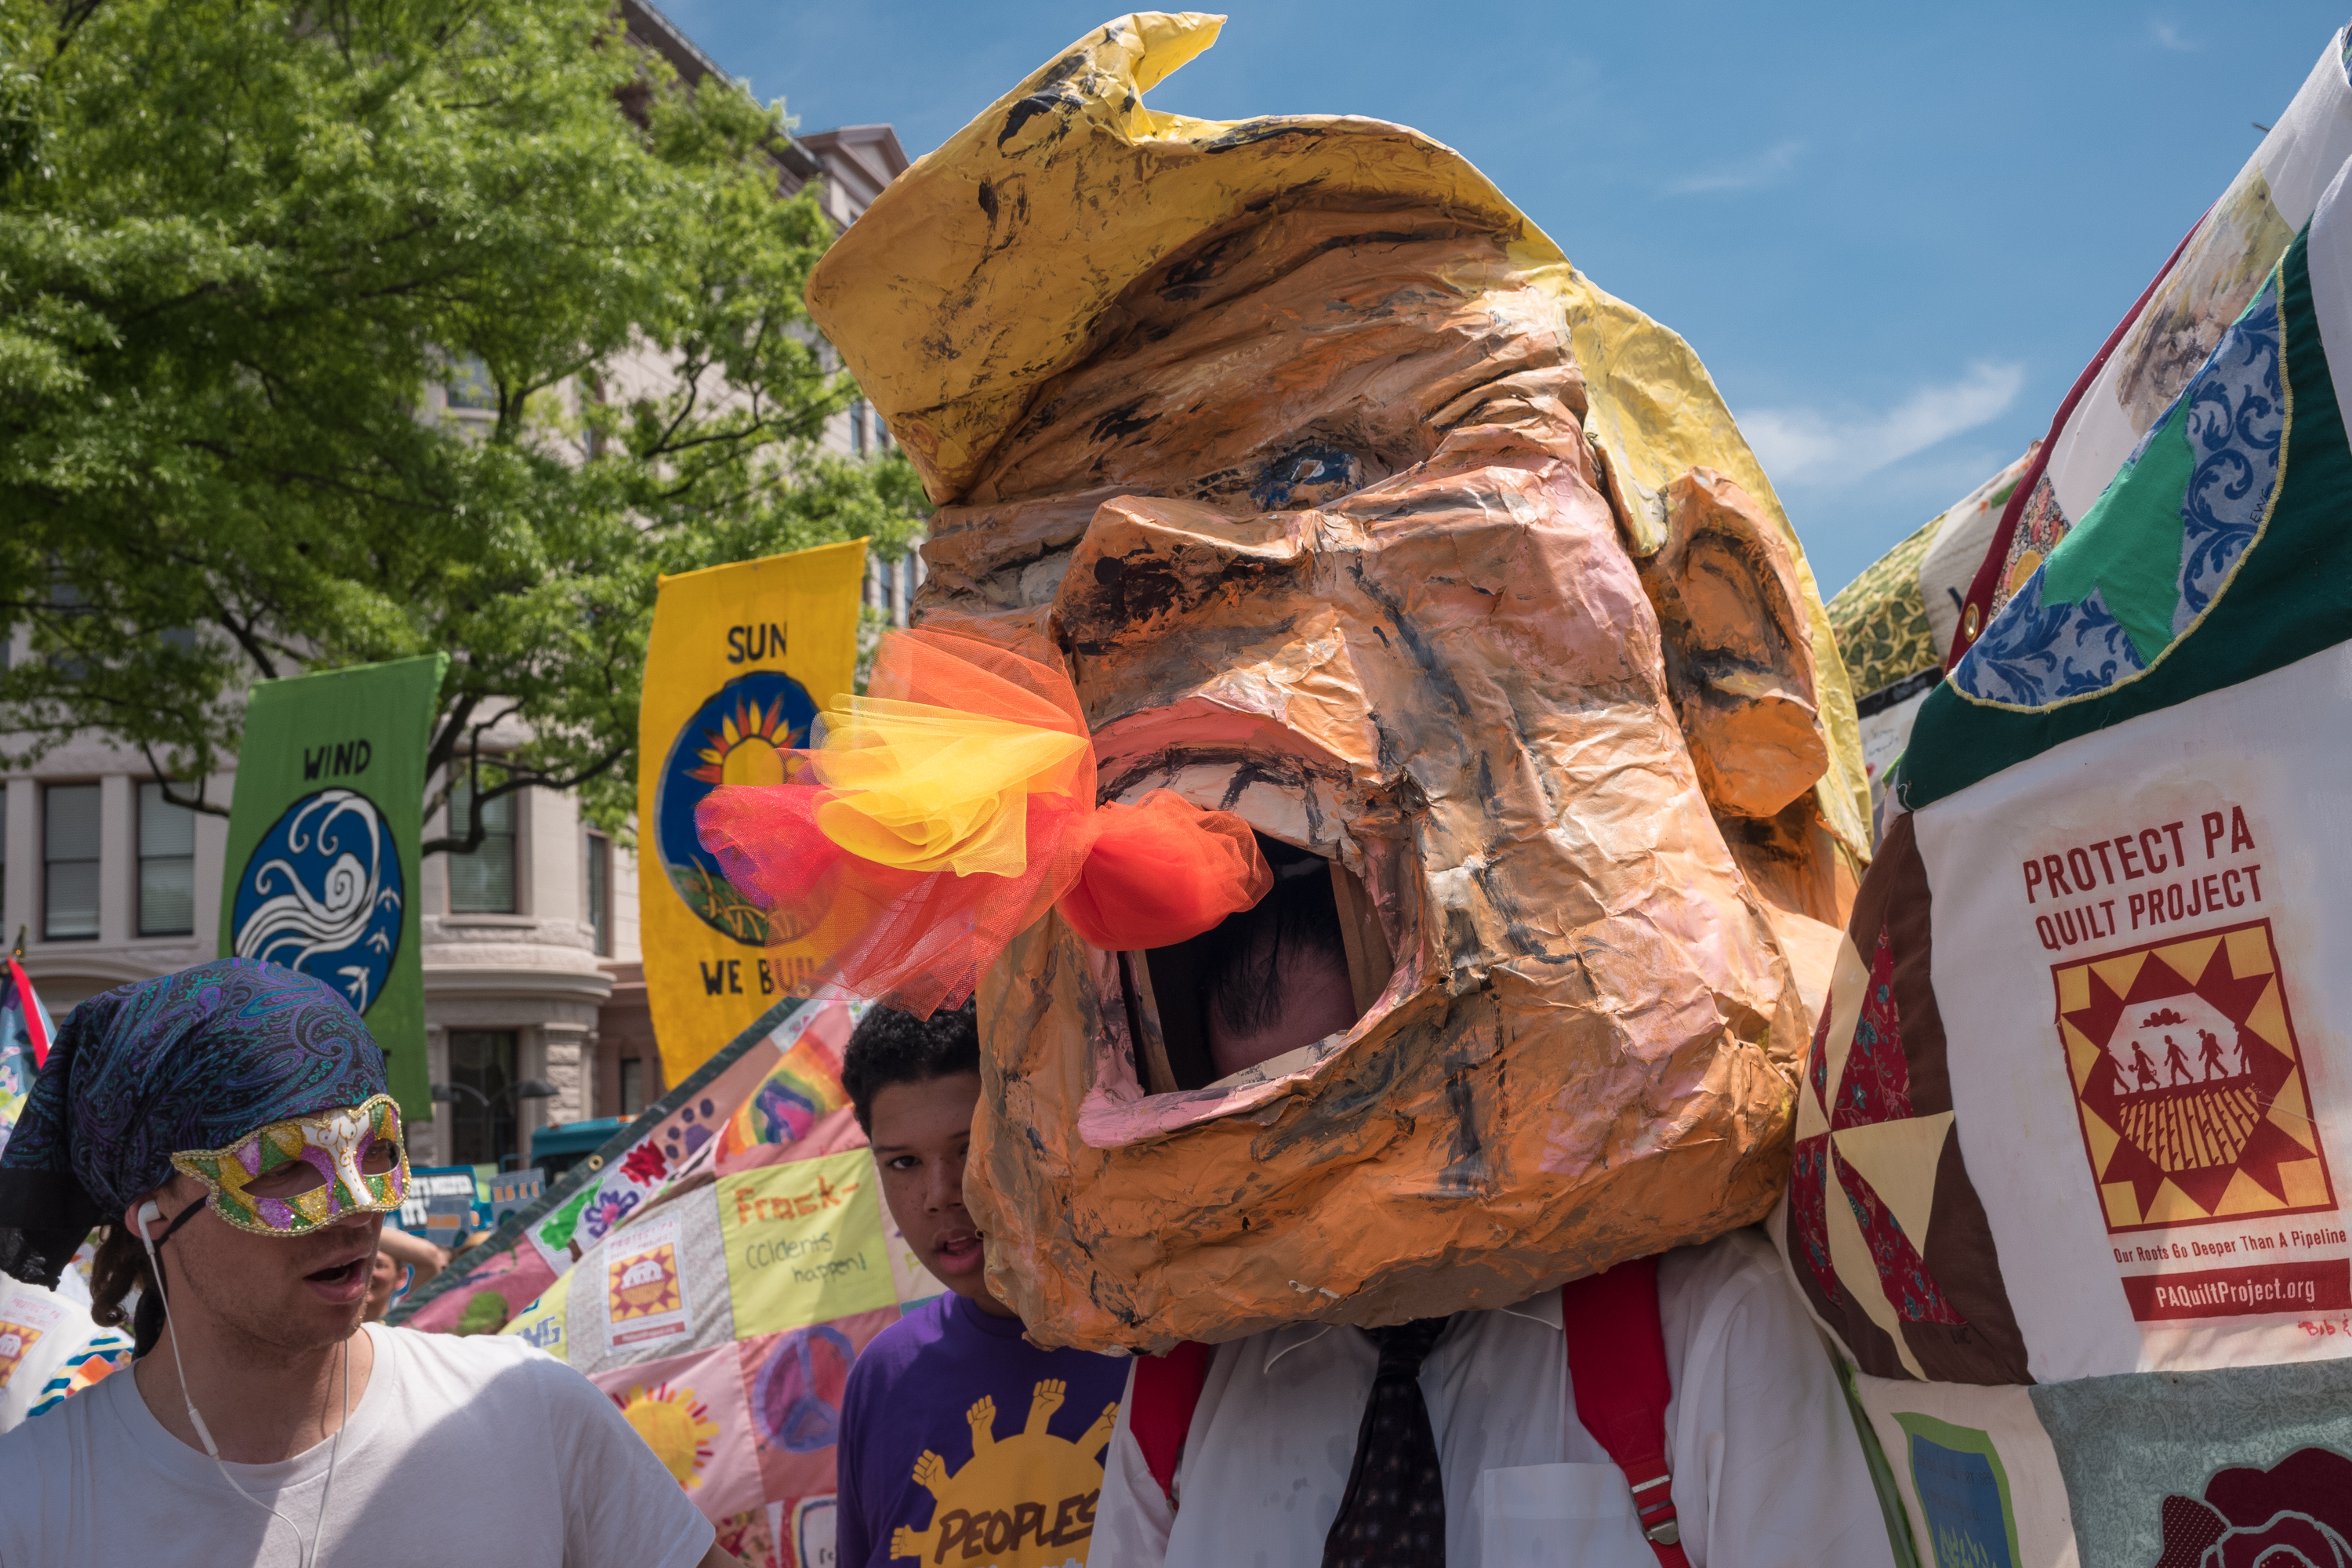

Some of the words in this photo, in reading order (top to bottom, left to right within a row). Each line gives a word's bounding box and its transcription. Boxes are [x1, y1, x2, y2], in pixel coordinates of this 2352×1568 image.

[726, 621, 788, 666] SUN
[303, 738, 372, 782] WIND
[2023, 821, 2185, 904] PROTECT
[2201, 805, 2256, 859] PA
[2035, 899, 2116, 952] QUILT
[2128, 864, 2262, 931] PROJECT
[700, 959, 743, 996] WE
[2113, 1247, 2133, 1264] Our
[2136, 1245, 2169, 1262] Roots
[2172, 1243, 2188, 1258] Go
[2190, 1240, 2237, 1258] Deeper
[2240, 1236, 2275, 1252] Than
[2278, 1232, 2288, 1248] A
[2291, 1228, 2347, 1249] Pipeline
[2155, 1278, 2315, 1308] PAQuiltProject.org
[515, 1316, 561, 1348] NG
